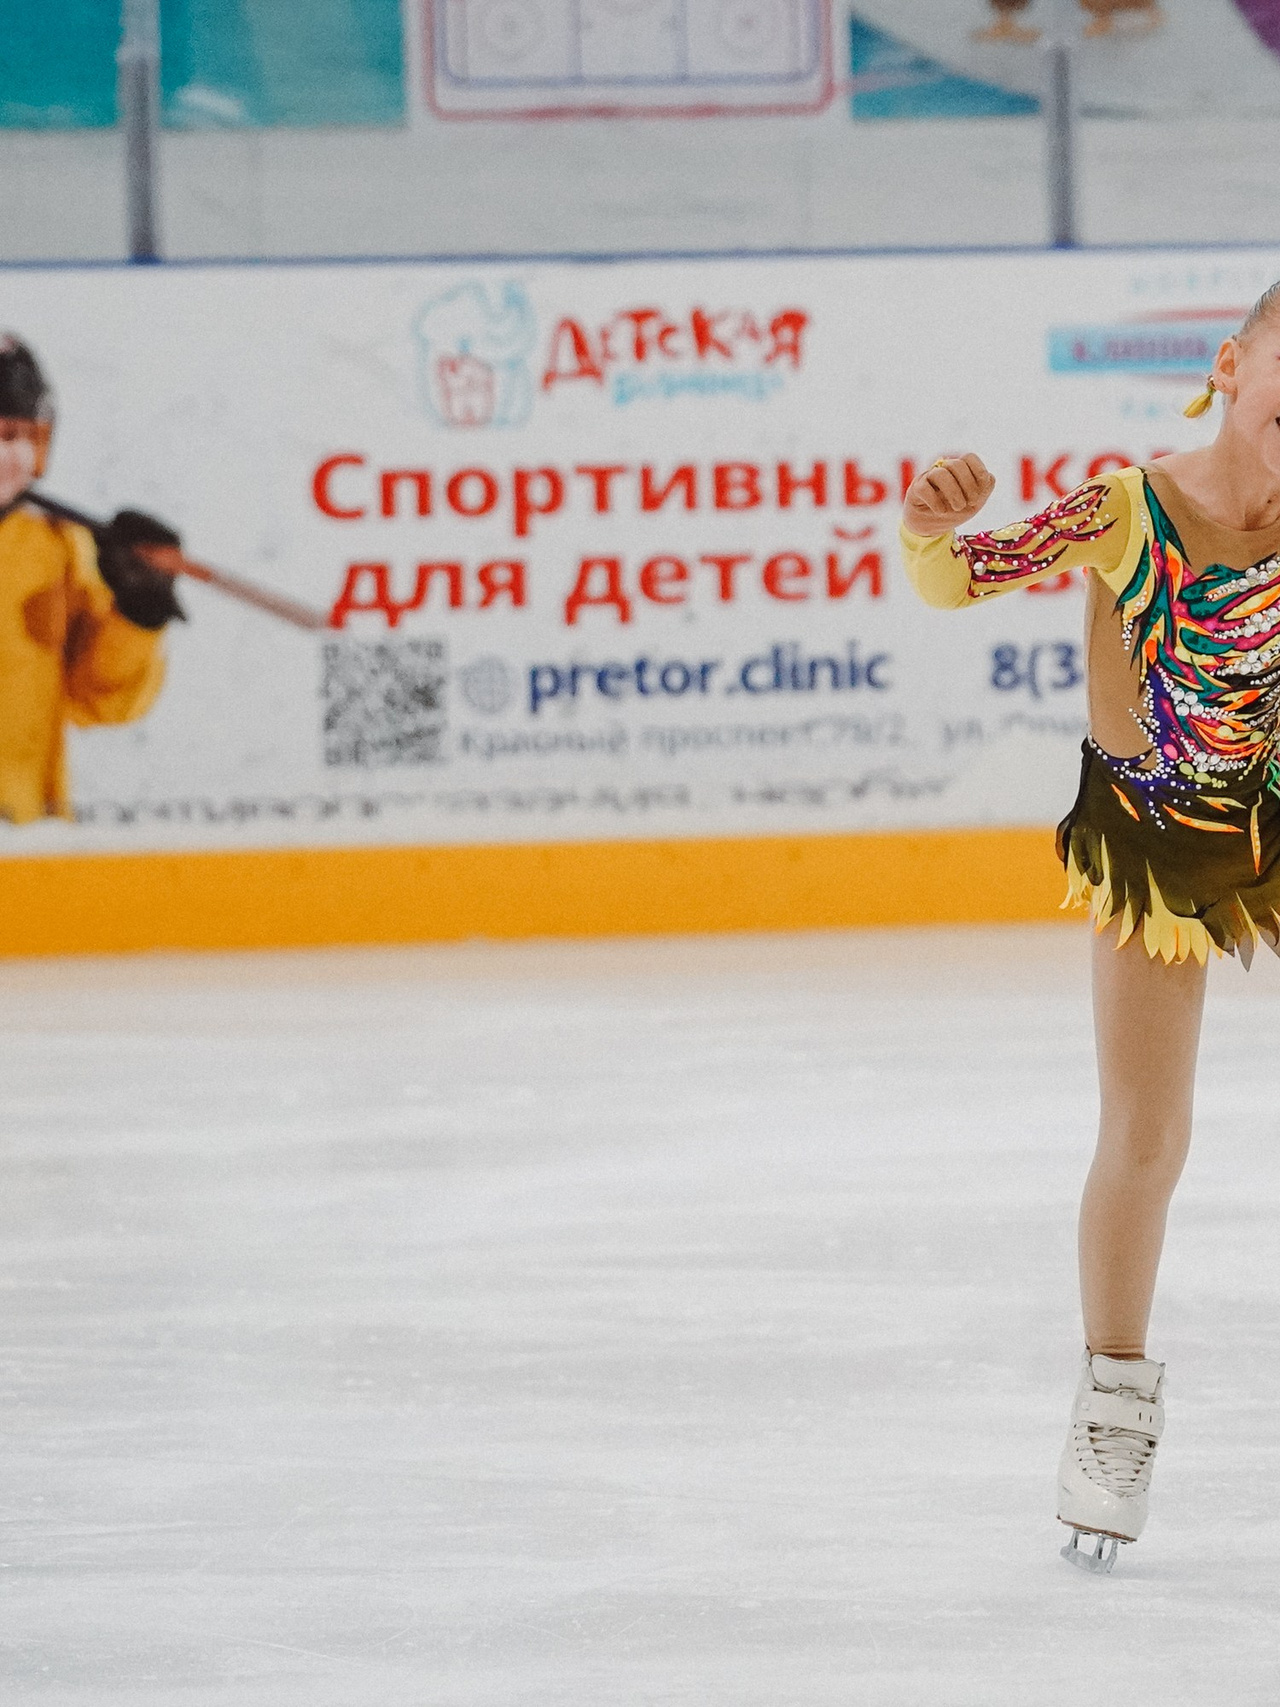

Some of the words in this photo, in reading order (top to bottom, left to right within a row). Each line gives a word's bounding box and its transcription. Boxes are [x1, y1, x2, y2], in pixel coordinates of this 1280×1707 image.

[311, 453, 963, 540] Спортивны
[330, 560, 527, 632] для
[563, 526, 886, 627] детей
[528, 641, 892, 716] pretor.clinic
